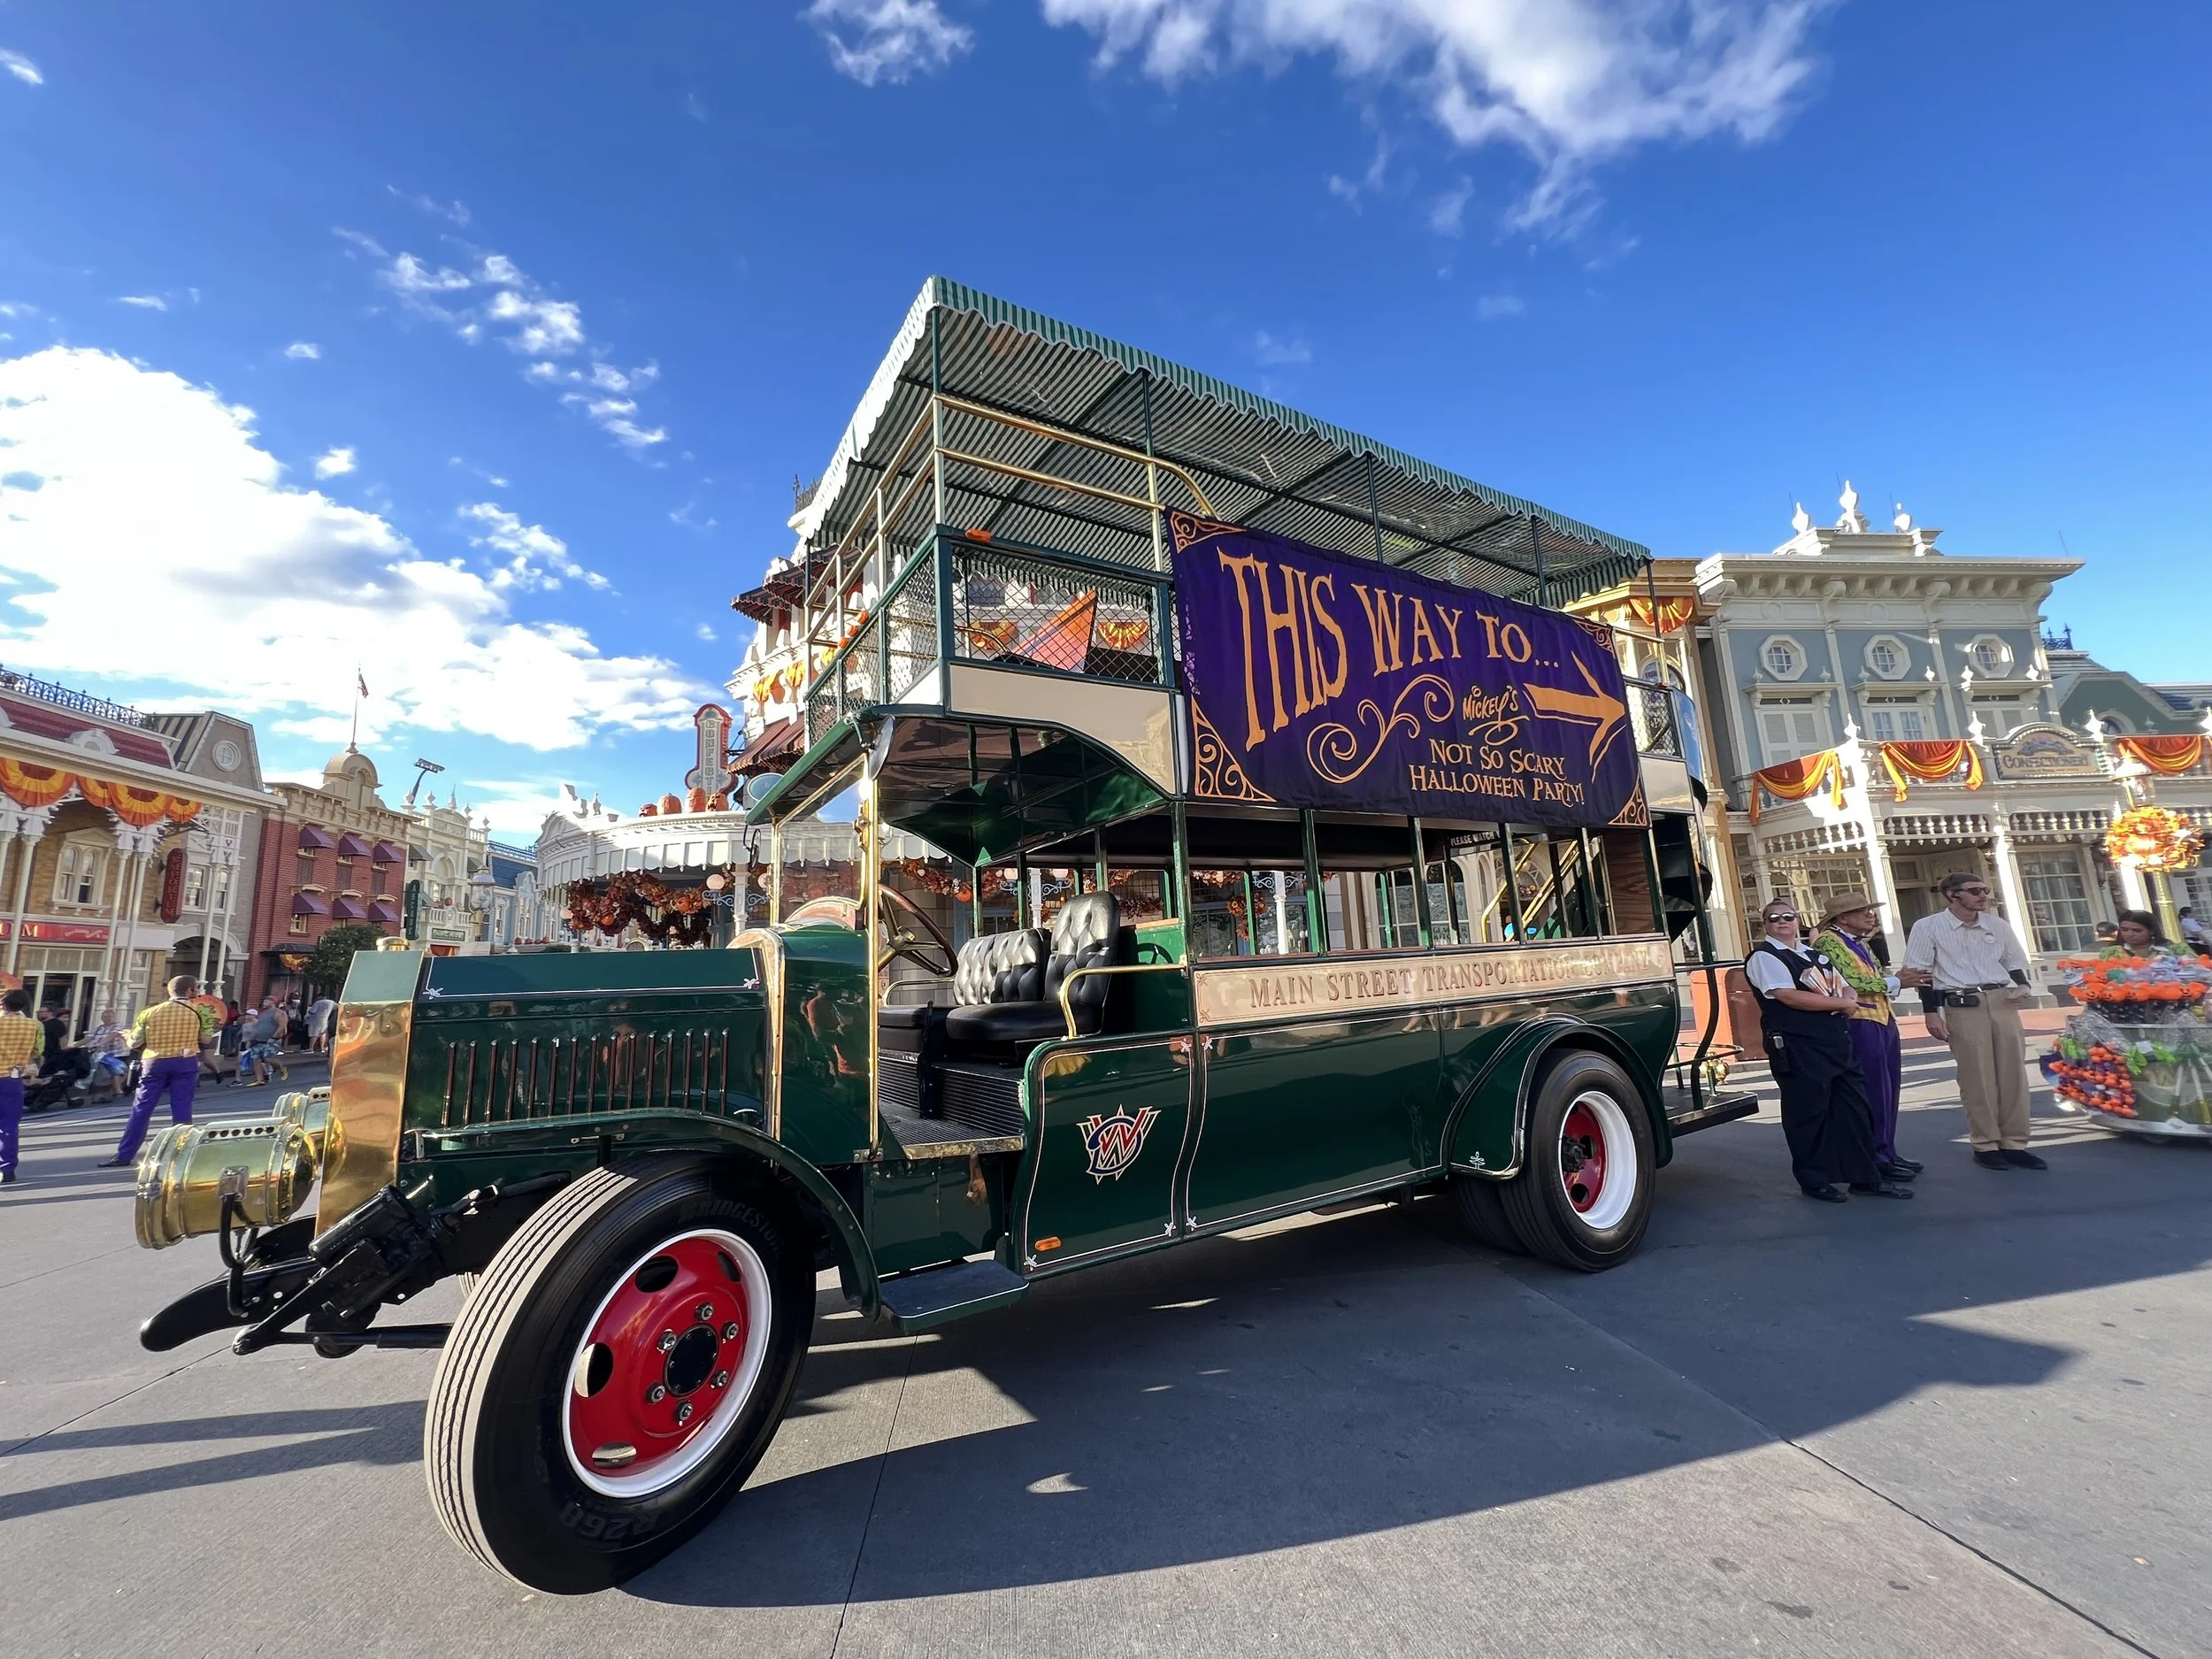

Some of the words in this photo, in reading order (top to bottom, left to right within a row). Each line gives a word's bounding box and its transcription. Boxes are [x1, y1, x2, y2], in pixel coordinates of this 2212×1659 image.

[1217, 546, 1348, 752] THIS
[1351, 583, 1463, 677] WAY
[1475, 610, 1559, 668] TO...
[704, 719, 716, 795] CONFECTI
[1429, 738, 1473, 766] NOT
[1479, 745, 1504, 770] SO
[1509, 748, 1567, 781] SCARY
[1409, 764, 1526, 798] HALLOWEEN
[1532, 777, 1586, 808] PARTY!
[1450, 834, 1472, 847] PLEASE
[1472, 831, 1495, 842] WATCH
[408, 884, 417, 935] ARCADE
[1248, 975, 1315, 1009] MAIN
[1327, 968, 1413, 1002] STREET
[1422, 956, 1575, 992] TRANSPORTATION
